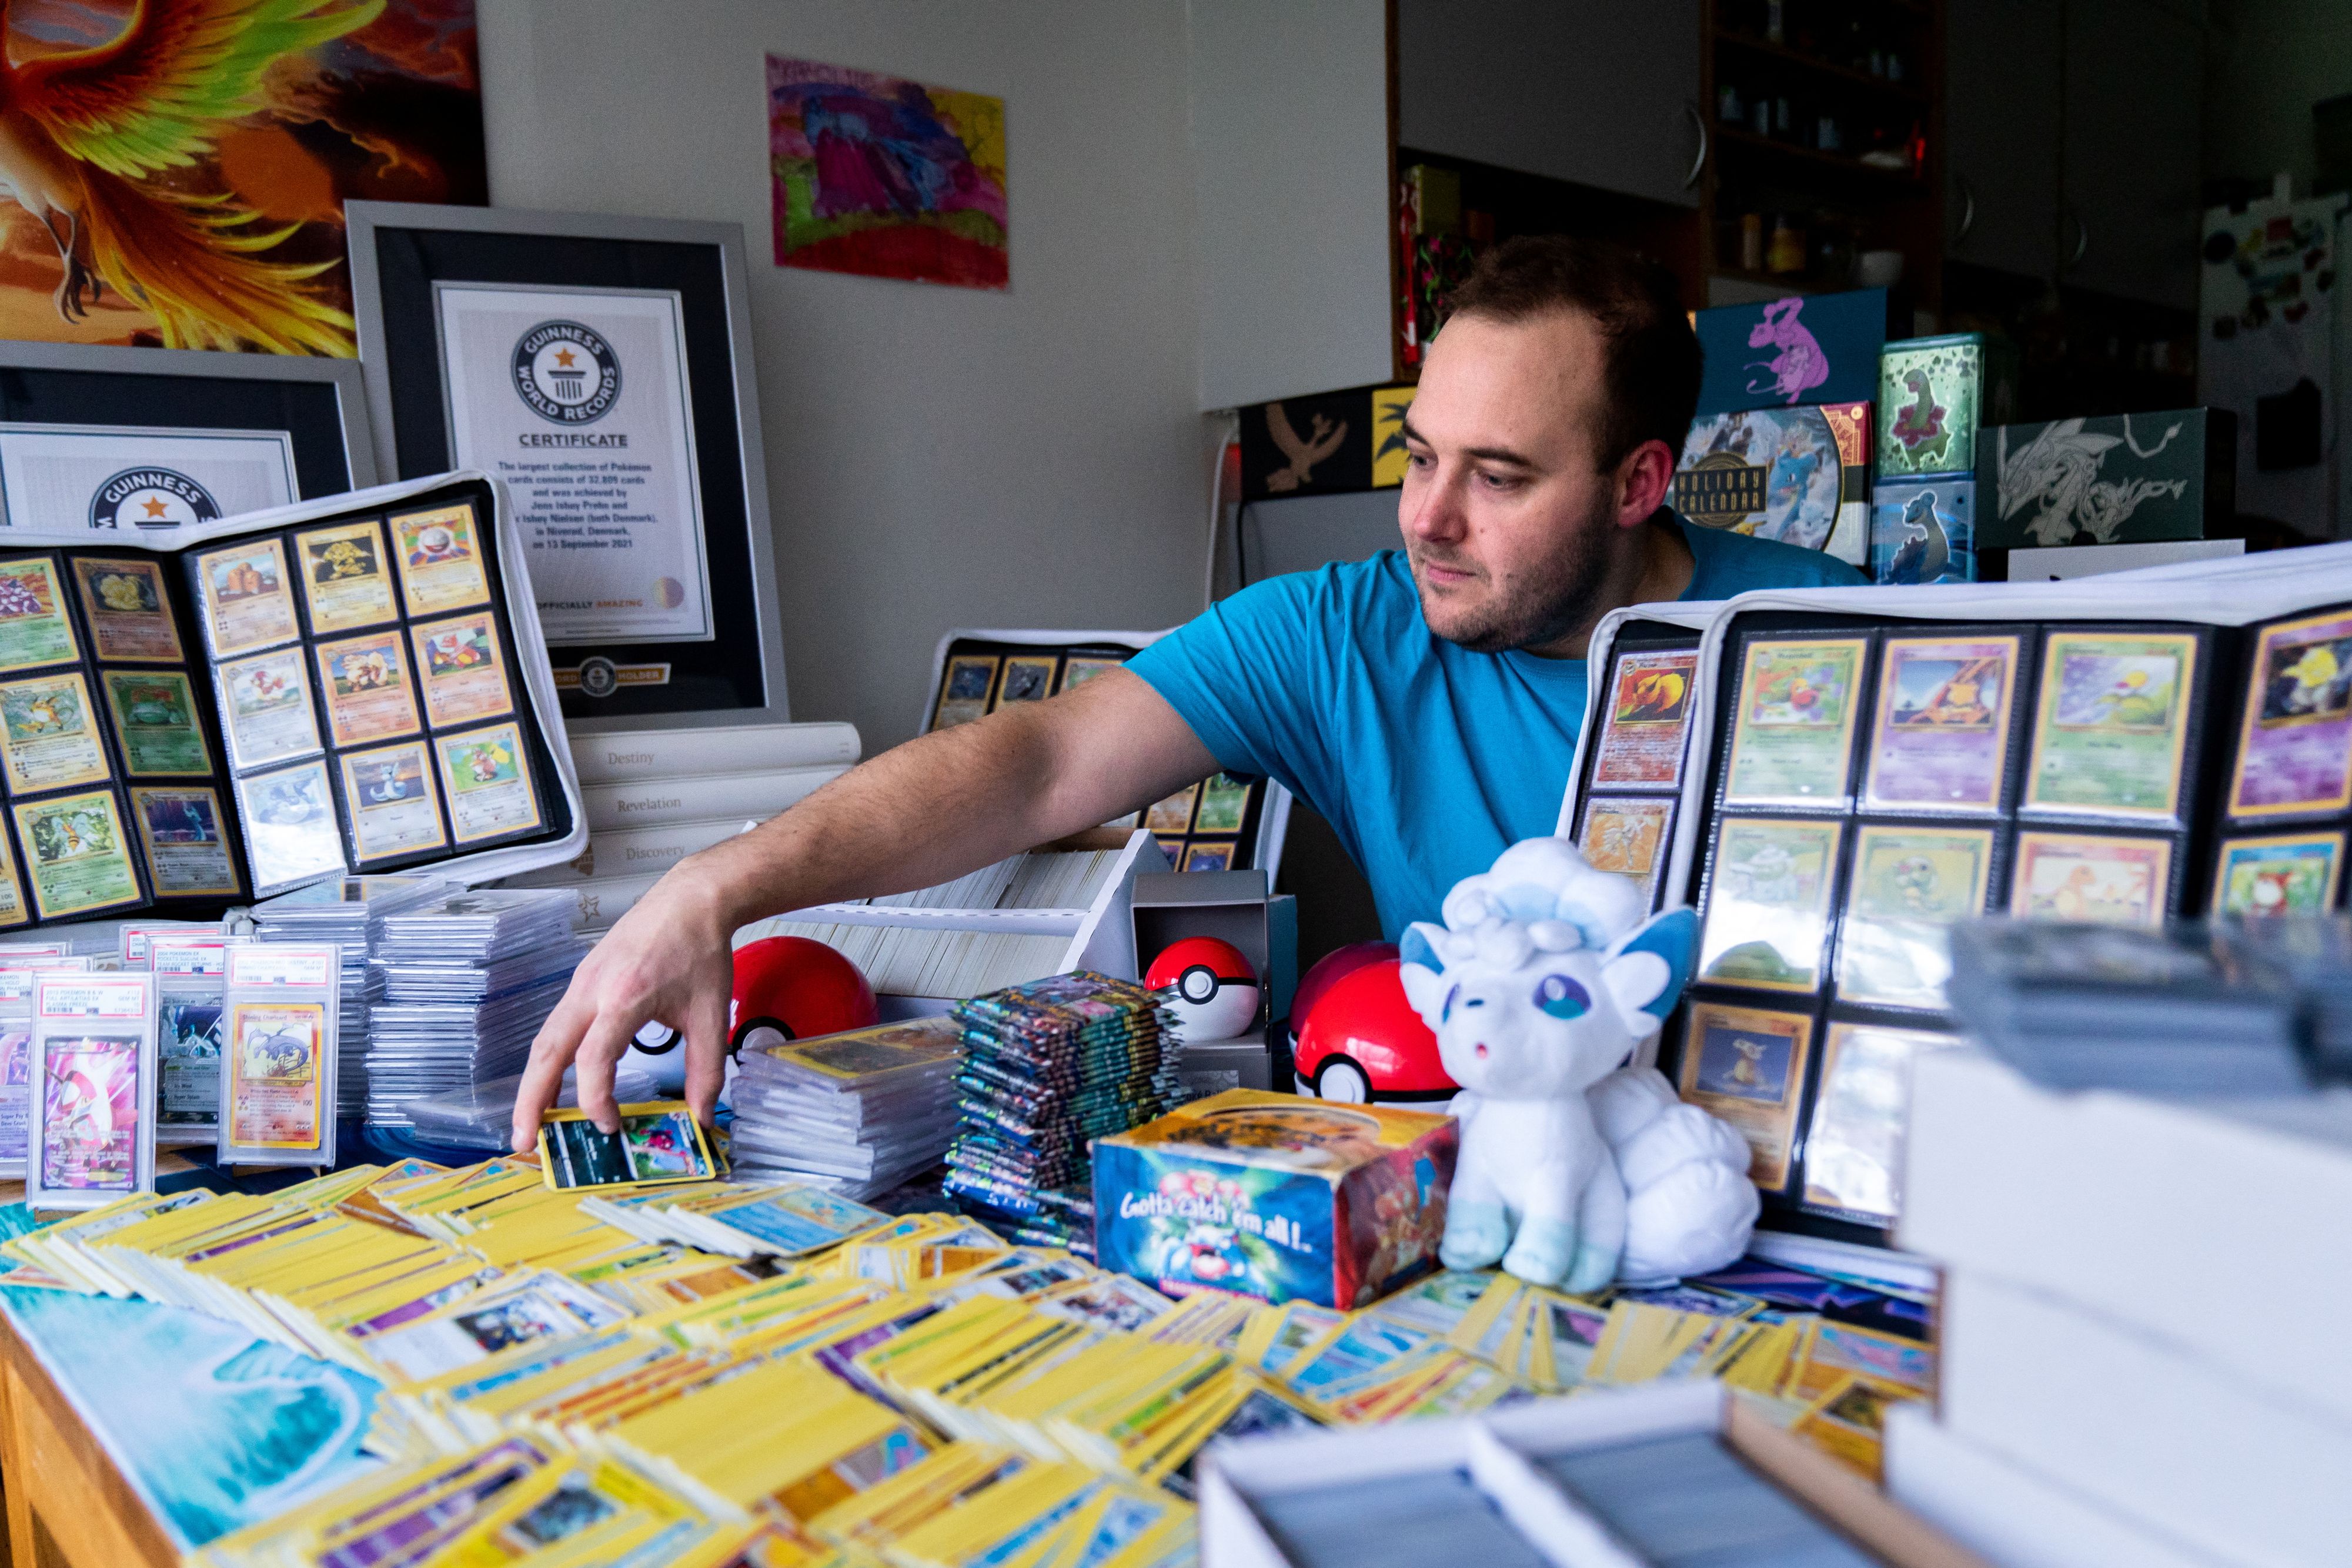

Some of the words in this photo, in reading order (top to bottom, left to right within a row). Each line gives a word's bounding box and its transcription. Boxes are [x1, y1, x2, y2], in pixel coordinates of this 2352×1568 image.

[523, 326, 604, 355] GUINNESS
[517, 365, 559, 415] WORLD
[564, 366, 616, 420] RECORDS
[519, 433, 628, 447] CERTIFICATE
[499, 461, 515, 470] The
[518, 463, 549, 473] largest
[553, 462, 597, 471] collection
[507, 475, 533, 484] cards
[577, 475, 586, 484] of
[621, 476, 645, 484] cards
[1679, 471, 1759, 493] HOLIDAY
[105, 473, 202, 503] GUINNESS
[616, 489, 627, 498] by
[1679, 492, 1759, 513] CALENDAR
[560, 539, 609, 551] September
[612, 539, 632, 548] 2021
[596, 600, 643, 609] AMAZING
[619, 671, 659, 680] HOLDER
[609, 752, 654, 765] Destiny
[617, 797, 682, 813] Revelation
[625, 845, 684, 861] Discovery
[1120, 1191, 1174, 1219] Gotta
[1177, 1193, 1227, 1223] catch
